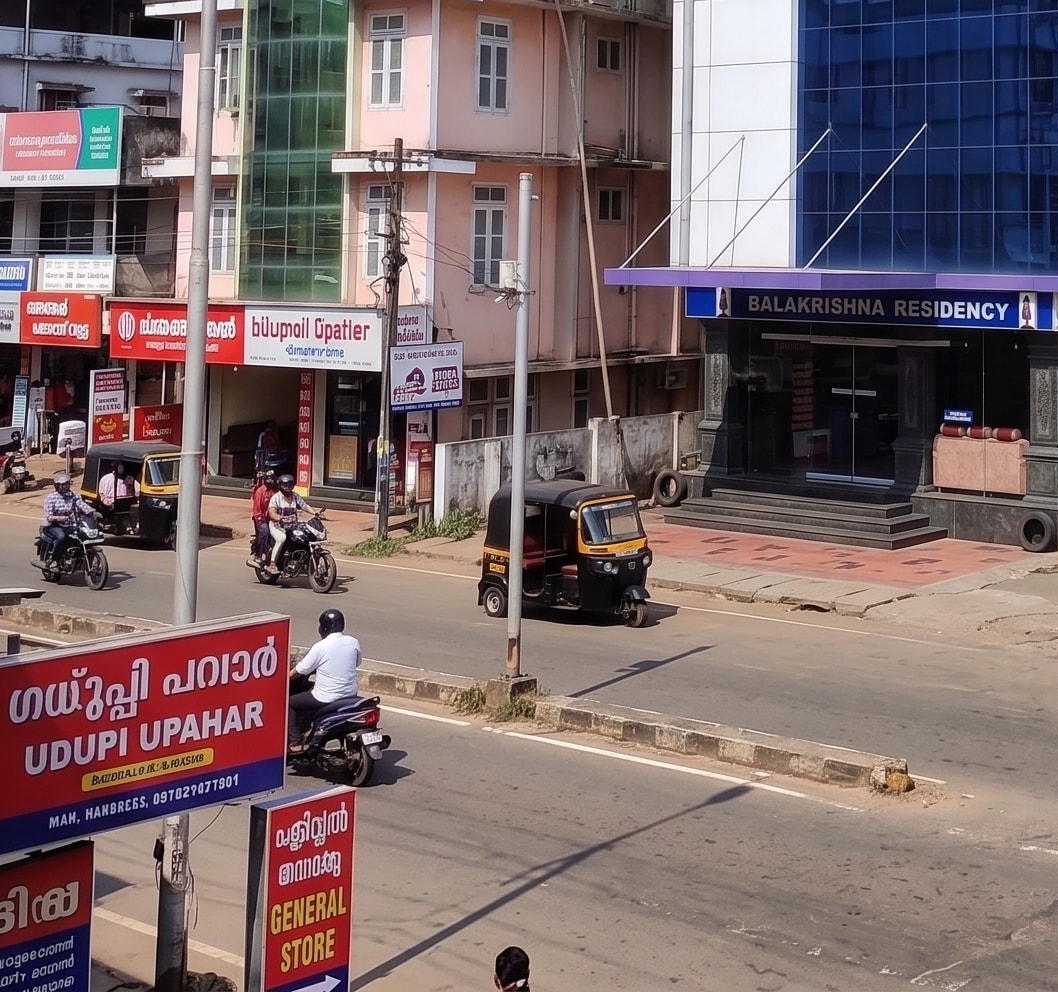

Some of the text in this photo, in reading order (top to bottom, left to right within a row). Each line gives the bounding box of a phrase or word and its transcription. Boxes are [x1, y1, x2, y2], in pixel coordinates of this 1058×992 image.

[748, 295, 1010, 321] BALAKRISHNA RESIDENCY
[24, 727, 128, 776] UDUPI
[139, 700, 264, 751] UPAHAR
[270, 886, 347, 935] GENERAL
[280, 927, 336, 973] STORE
